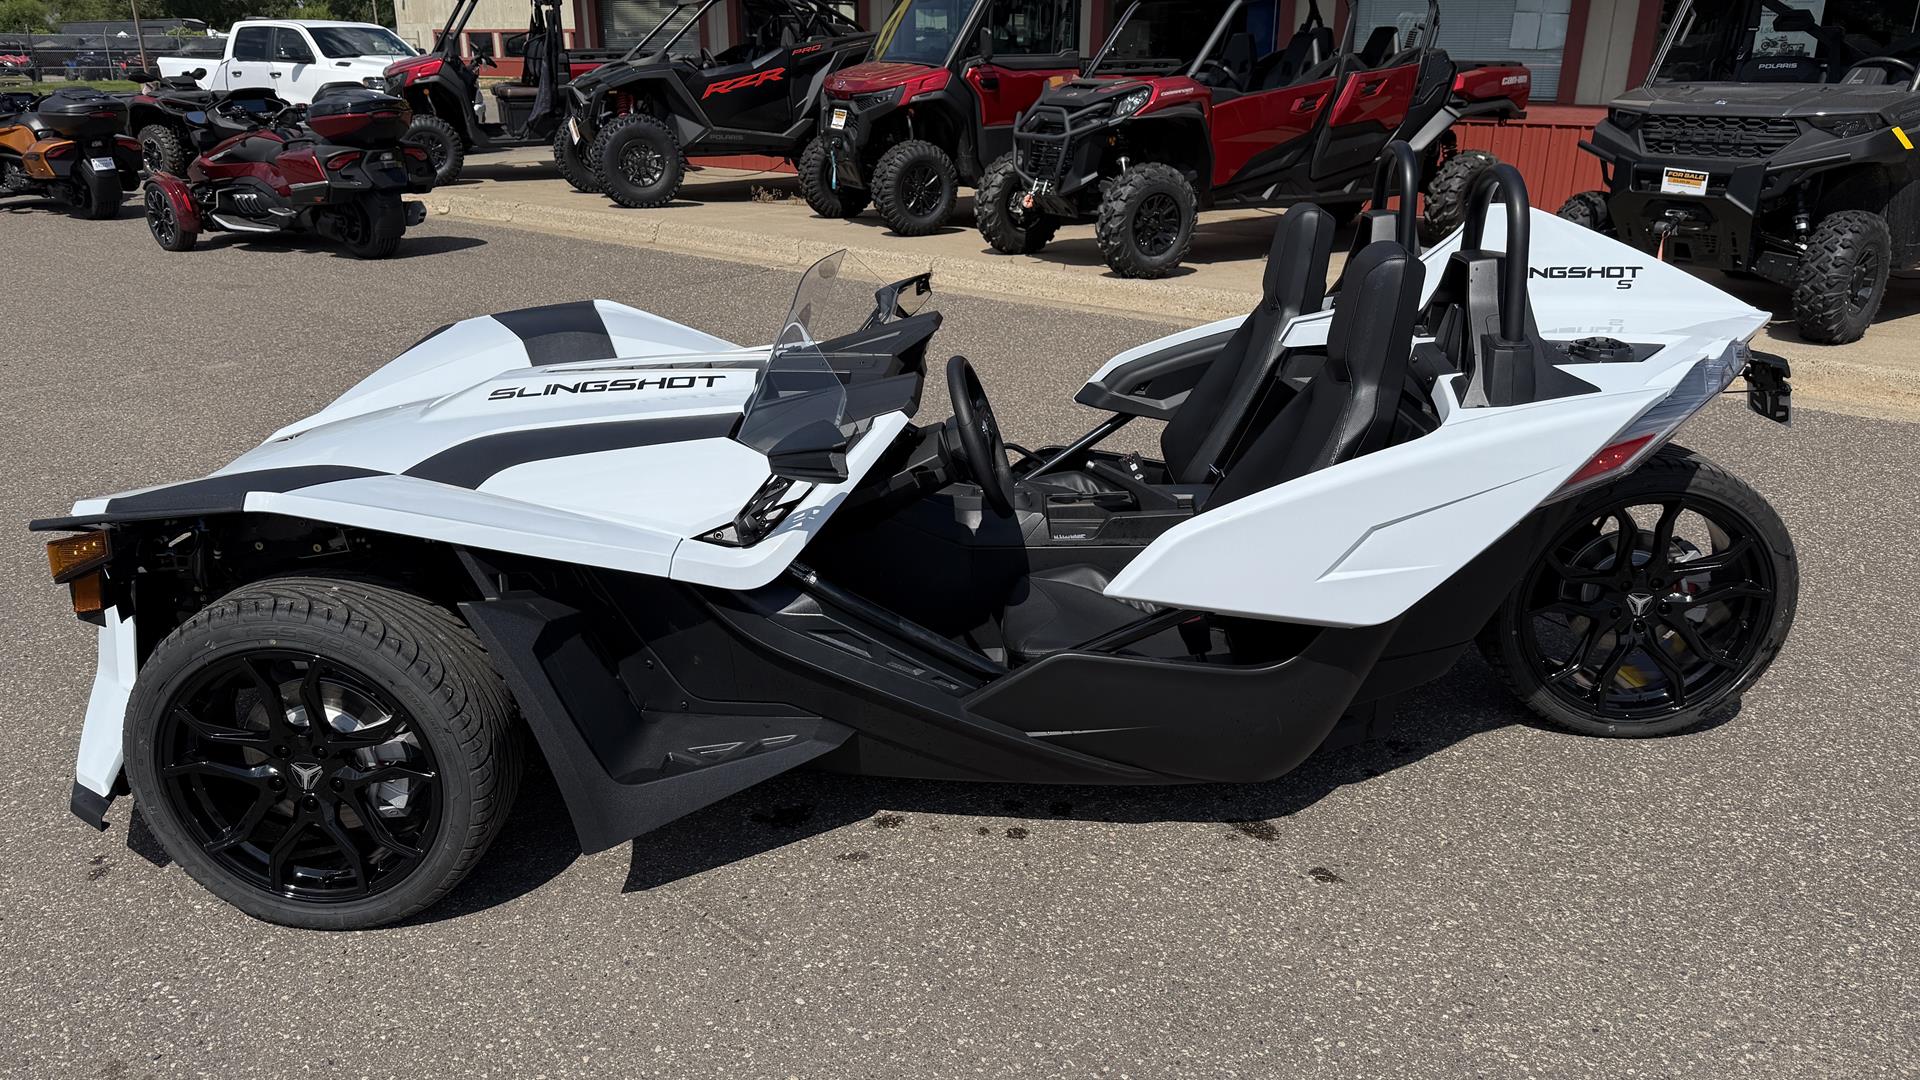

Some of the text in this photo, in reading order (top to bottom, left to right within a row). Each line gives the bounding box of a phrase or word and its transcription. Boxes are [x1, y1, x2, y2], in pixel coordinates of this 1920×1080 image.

[791, 44, 822, 56] PRO
[1758, 62, 1798, 70] POLARIS
[701, 67, 786, 100] RZR
[709, 133, 745, 142] POLARIS
[1667, 171, 1705, 181] FOR SALE
[1528, 266, 1644, 279] NGSHOT
[1616, 279, 1634, 290] S
[487, 375, 727, 401] SLINGSHOT
